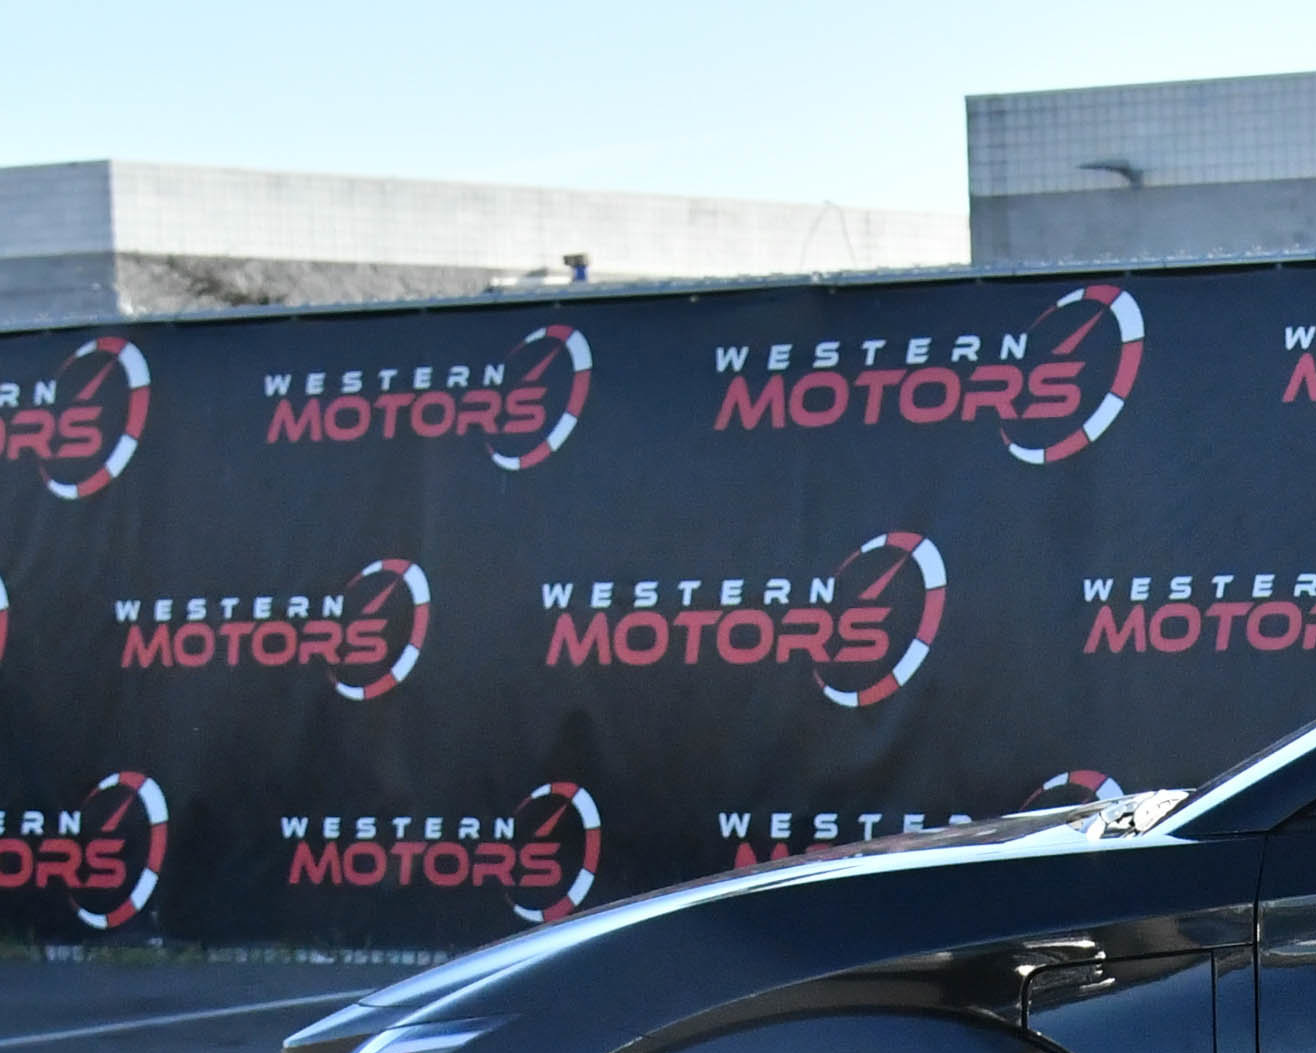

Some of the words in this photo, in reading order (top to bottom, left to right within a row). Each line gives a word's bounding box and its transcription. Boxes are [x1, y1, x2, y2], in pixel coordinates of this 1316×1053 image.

[716, 333, 1027, 372] WESTERN
[264, 364, 505, 395] WESTERN
[714, 361, 1086, 431] MOTORS
[266, 386, 548, 444] MOTORS
[115, 594, 345, 622] WESTERN
[542, 577, 835, 610] WESTERN
[121, 619, 388, 668] MOTORS
[546, 607, 892, 666] MOTORS
[280, 816, 515, 840] WESTERN
[288, 841, 562, 887] MOTORS
